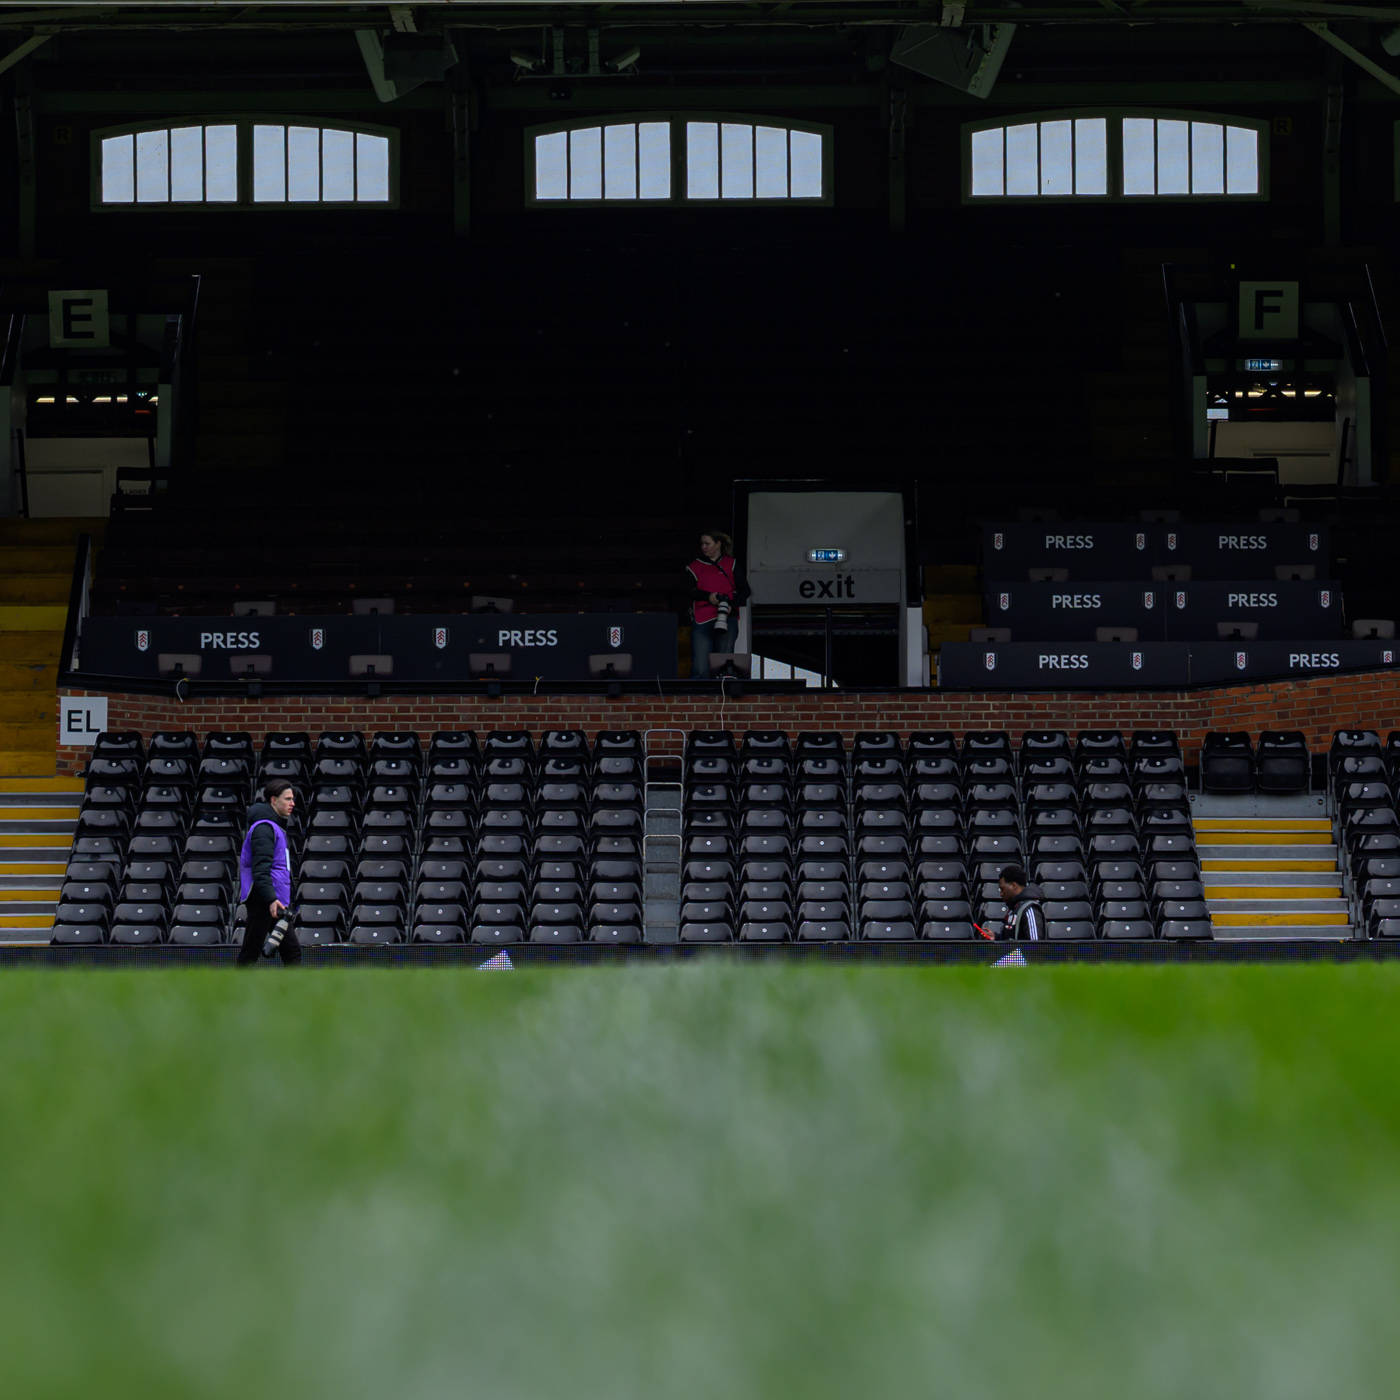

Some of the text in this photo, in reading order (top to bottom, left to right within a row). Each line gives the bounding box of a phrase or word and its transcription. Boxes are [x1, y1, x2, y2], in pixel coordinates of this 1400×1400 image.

[1254, 289, 1284, 330] F
[62, 299, 95, 339] E
[1045, 535, 1095, 550] PRESS
[1218, 535, 1269, 550] PRESS
[799, 573, 855, 599] exit
[1051, 594, 1102, 609] PRESS
[1228, 592, 1279, 608] PRESS
[200, 631, 261, 649] PRESS
[498, 629, 559, 647] PRESS
[1038, 654, 1090, 669] PRESS
[1288, 653, 1341, 668] PRESS
[67, 710, 100, 732] EL
